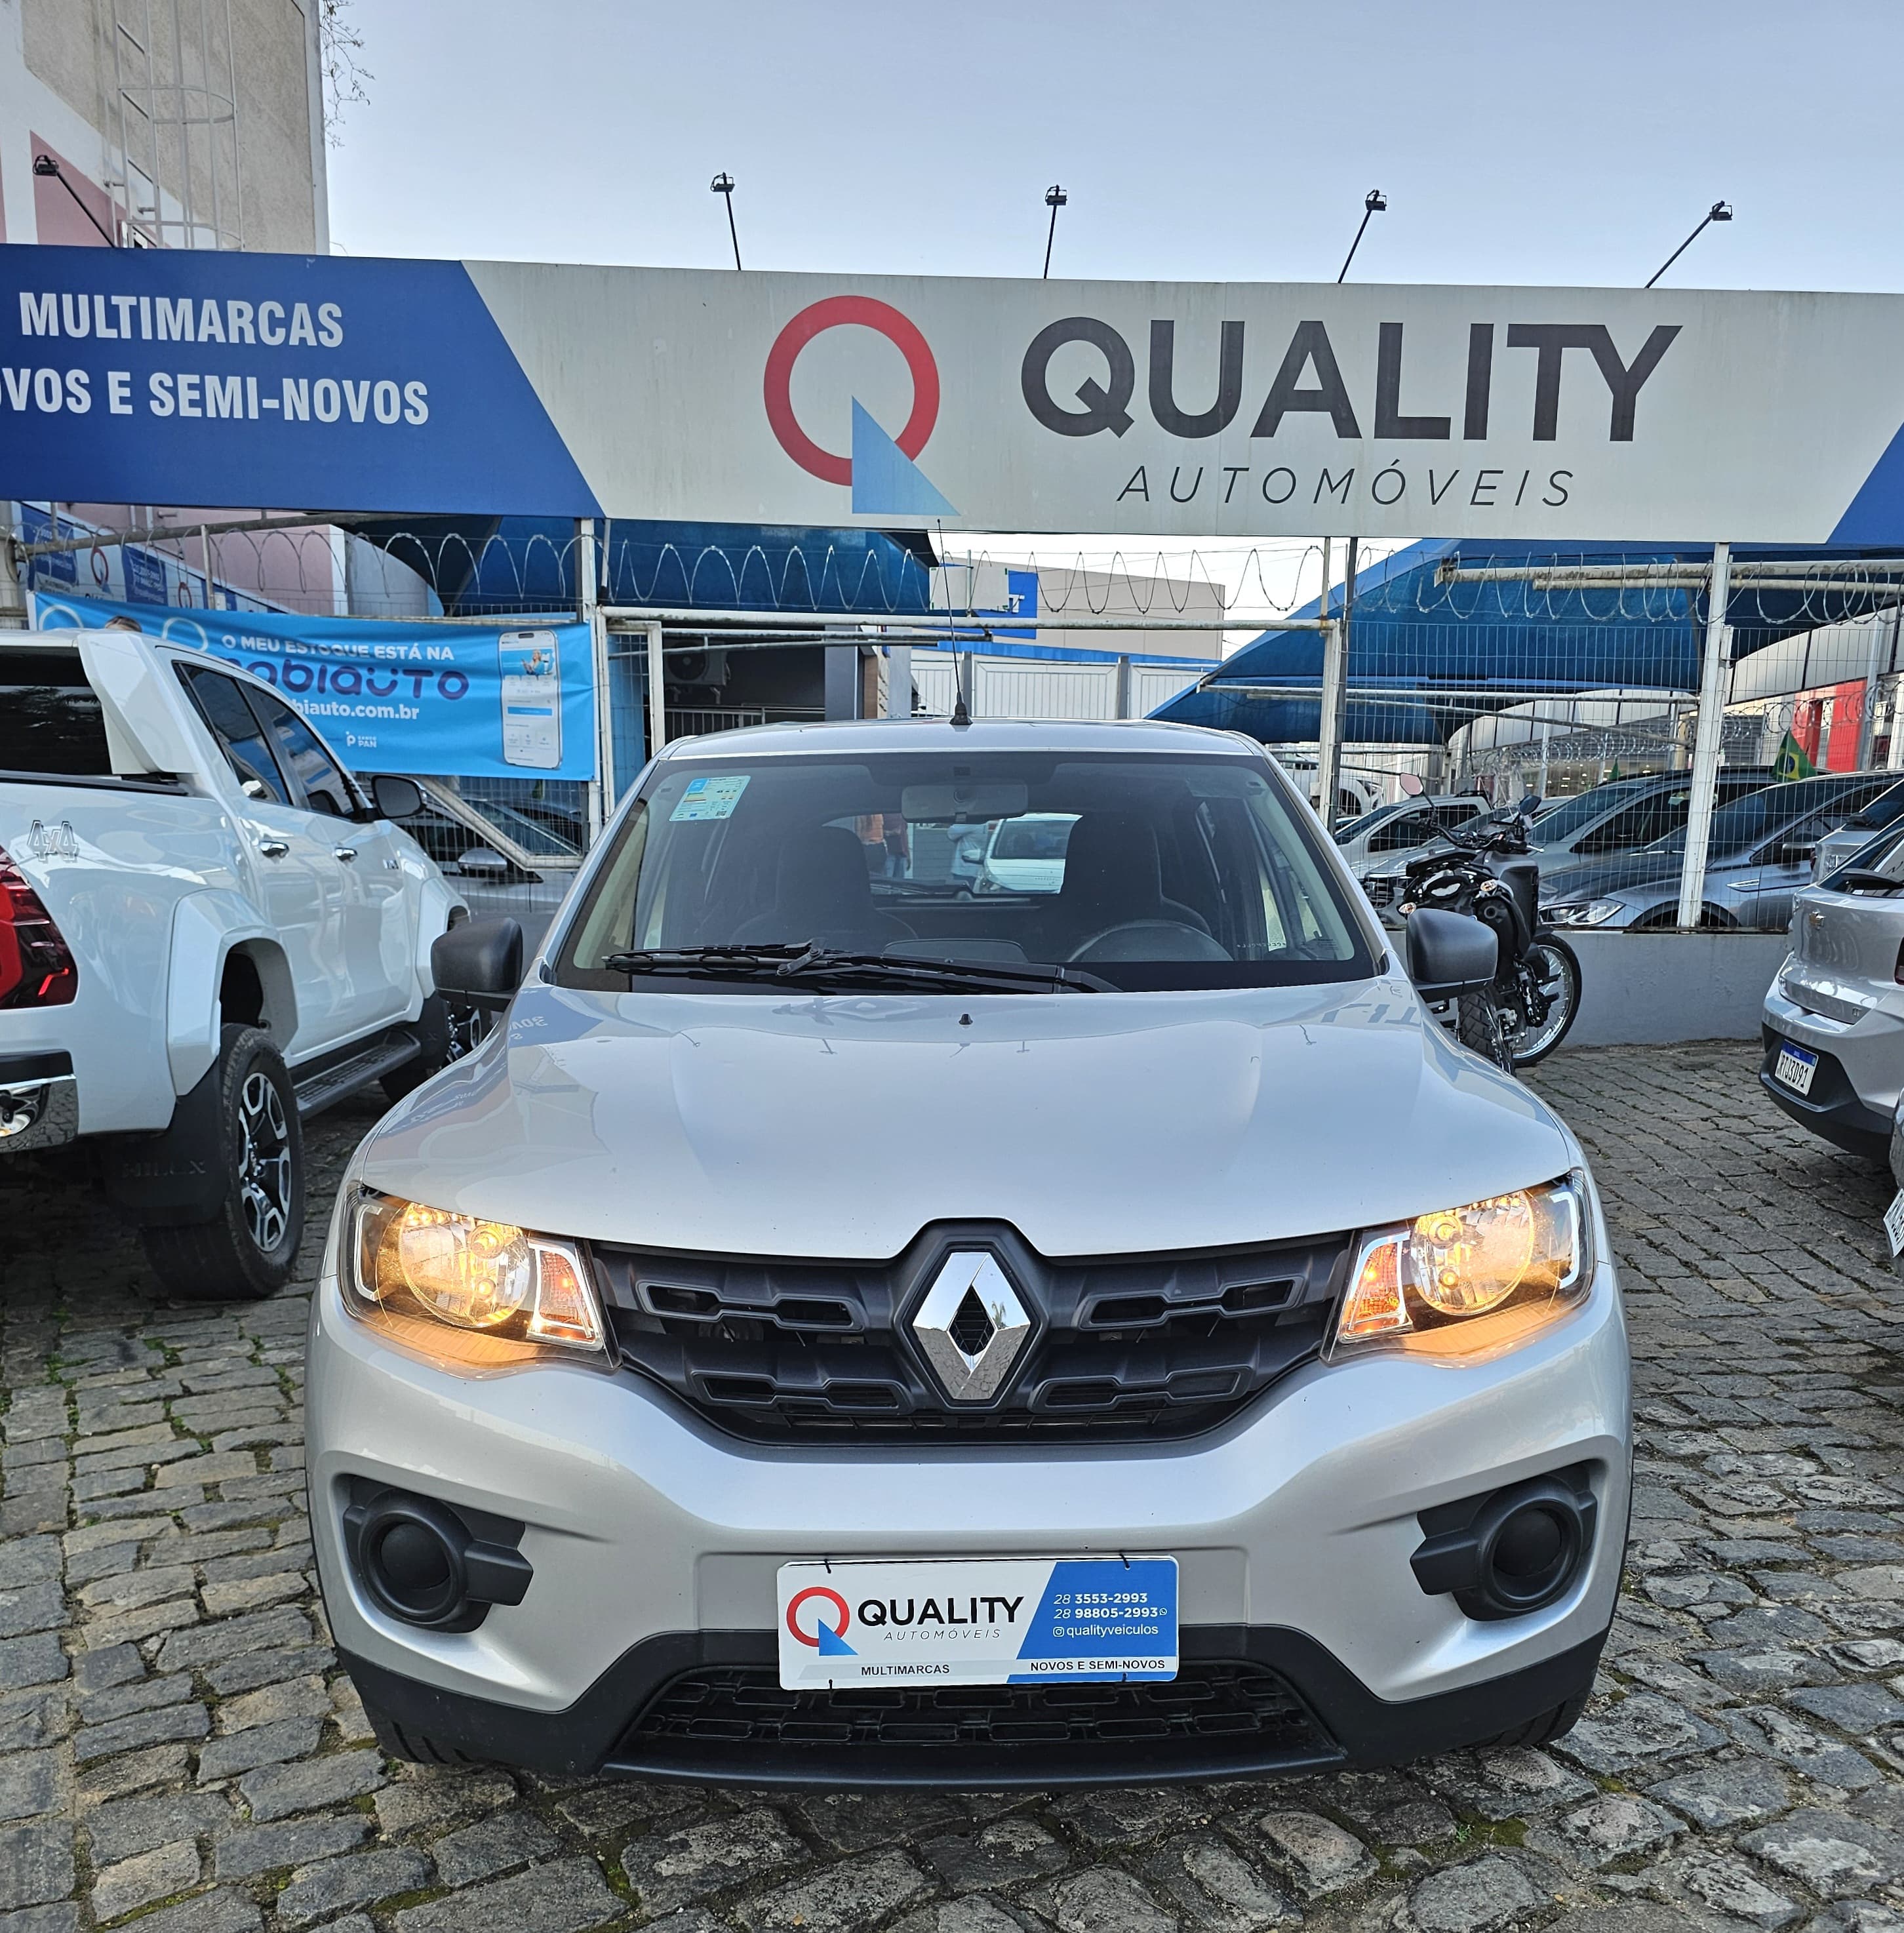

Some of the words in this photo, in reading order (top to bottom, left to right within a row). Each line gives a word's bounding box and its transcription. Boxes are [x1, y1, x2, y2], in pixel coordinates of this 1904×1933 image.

[20, 292, 344, 348] MULTIMARCAS
[1021, 317, 1683, 442] QUALITY
[0, 368, 92, 414] VOS
[108, 371, 133, 414] E
[149, 372, 429, 425] SEMI-NOVOS
[1117, 459, 1574, 508] AUTOMÓVEIS
[222, 634, 237, 649] O
[241, 635, 281, 652] MEU
[285, 640, 370, 658] ESTOQUE
[374, 643, 422, 660] ESTÁ
[427, 646, 455, 660] NA
[292, 698, 420, 720] biauto.com.br
[1054, 1594, 1071, 1604] 28
[1075, 1593, 1148, 1604] 3553-2993
[858, 1597, 1024, 1626] QUALITY
[1054, 1608, 1071, 1619] 28
[1075, 1607, 1158, 1618] 98805-2993
[884, 1628, 1001, 1641] AUTOMÓVEIS
[1066, 1624, 1159, 1638] qualityveiculos
[861, 1665, 950, 1676] MULTIMARCAS
[1030, 1662, 1073, 1671] NOVOS
[1078, 1662, 1085, 1670] E
[1088, 1660, 1166, 1670] SEMI-NOVOS
